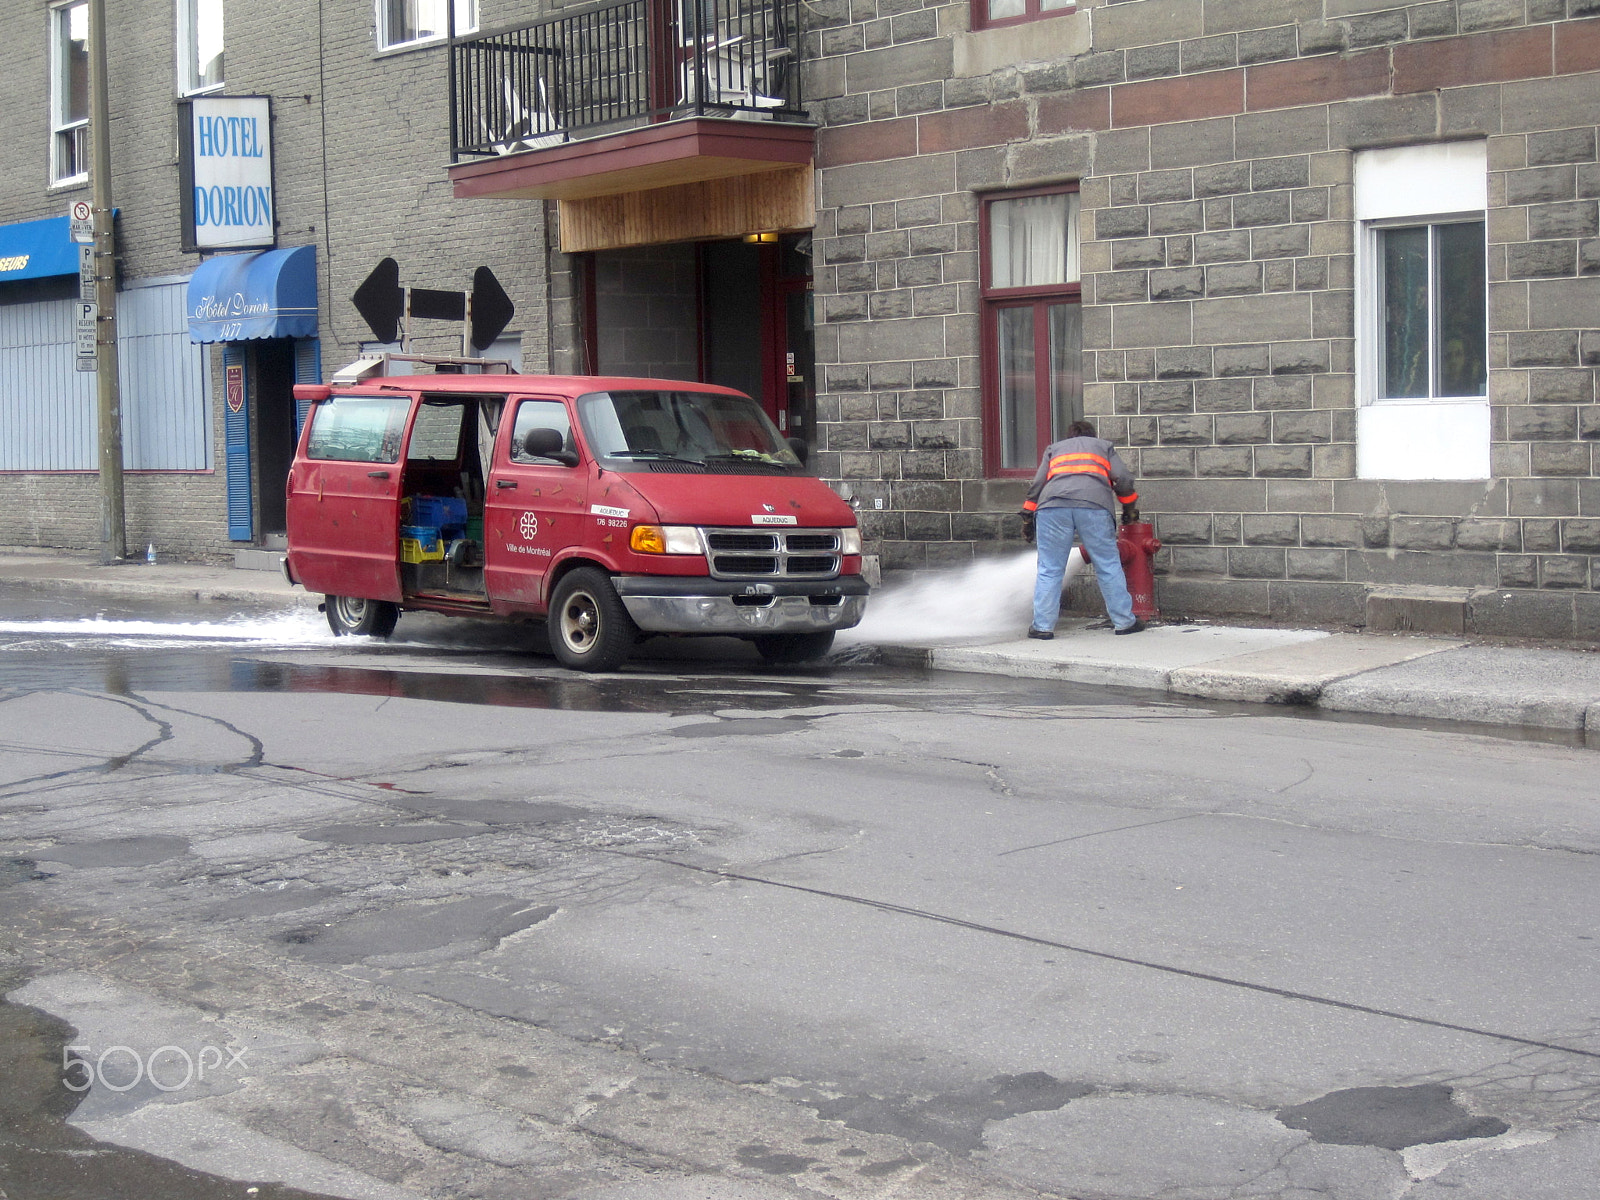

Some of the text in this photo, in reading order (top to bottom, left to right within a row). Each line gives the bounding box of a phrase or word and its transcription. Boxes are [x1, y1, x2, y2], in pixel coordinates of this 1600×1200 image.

[198, 115, 264, 158] HOTEL
[194, 185, 271, 227] DORION
[85, 248, 91, 260] P
[83, 304, 92, 319] P
[195, 292, 270, 319] Hôtel Dorion
[220, 322, 242, 338] 1477
[600, 508, 625, 517] AQUEDUC
[607, 519, 628, 528] 98226
[506, 543, 552, 557] Ville de Montréal
